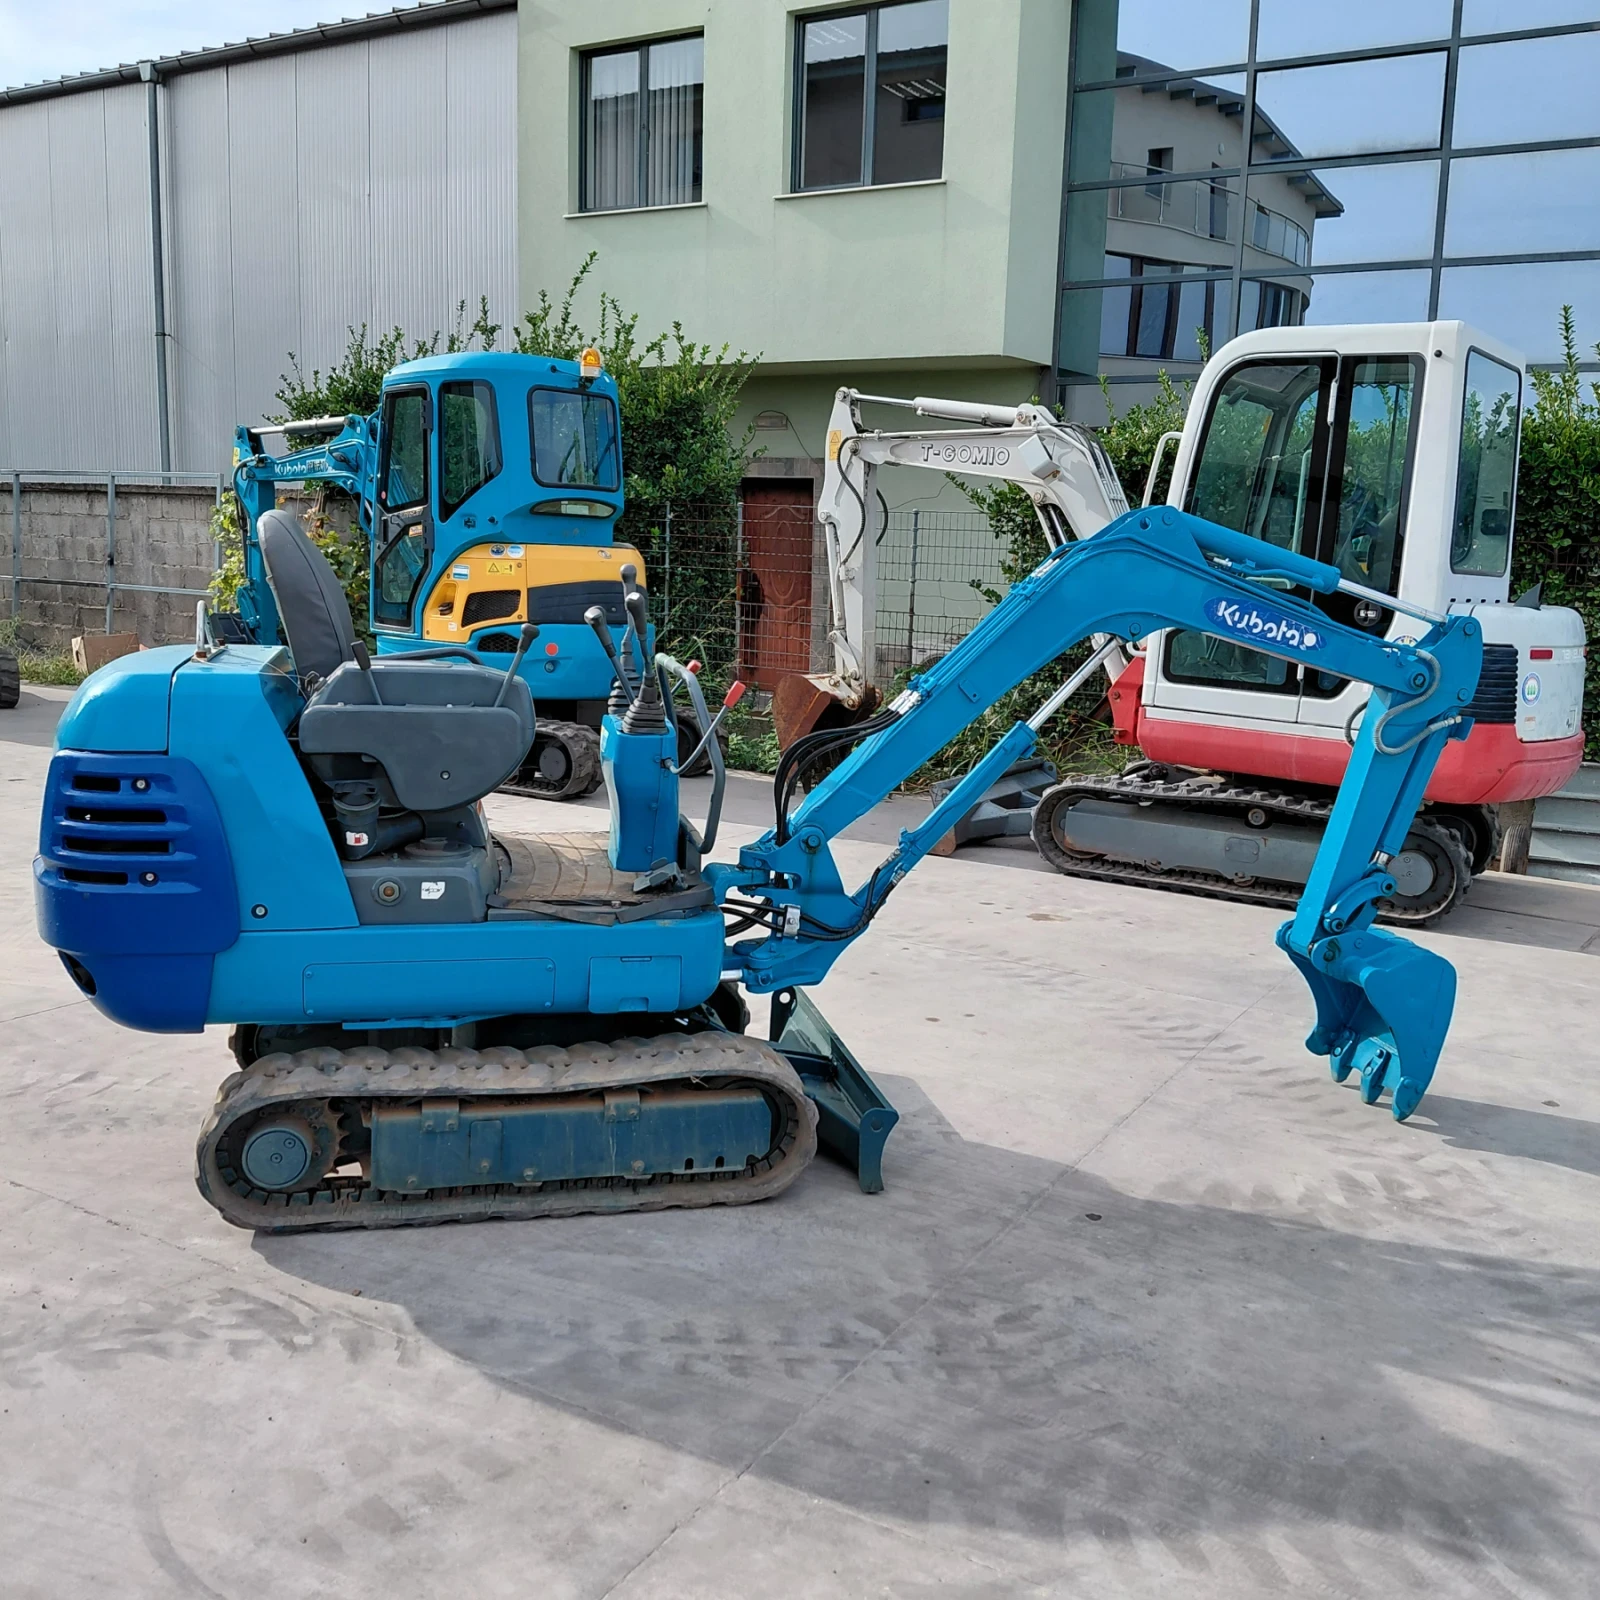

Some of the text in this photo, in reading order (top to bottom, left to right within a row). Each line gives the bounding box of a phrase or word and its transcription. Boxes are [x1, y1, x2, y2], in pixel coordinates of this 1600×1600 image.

[921, 443, 1010, 466] T-GOMIO
[274, 462, 307, 475] Kubota
[1217, 600, 1300, 647] Kubota
